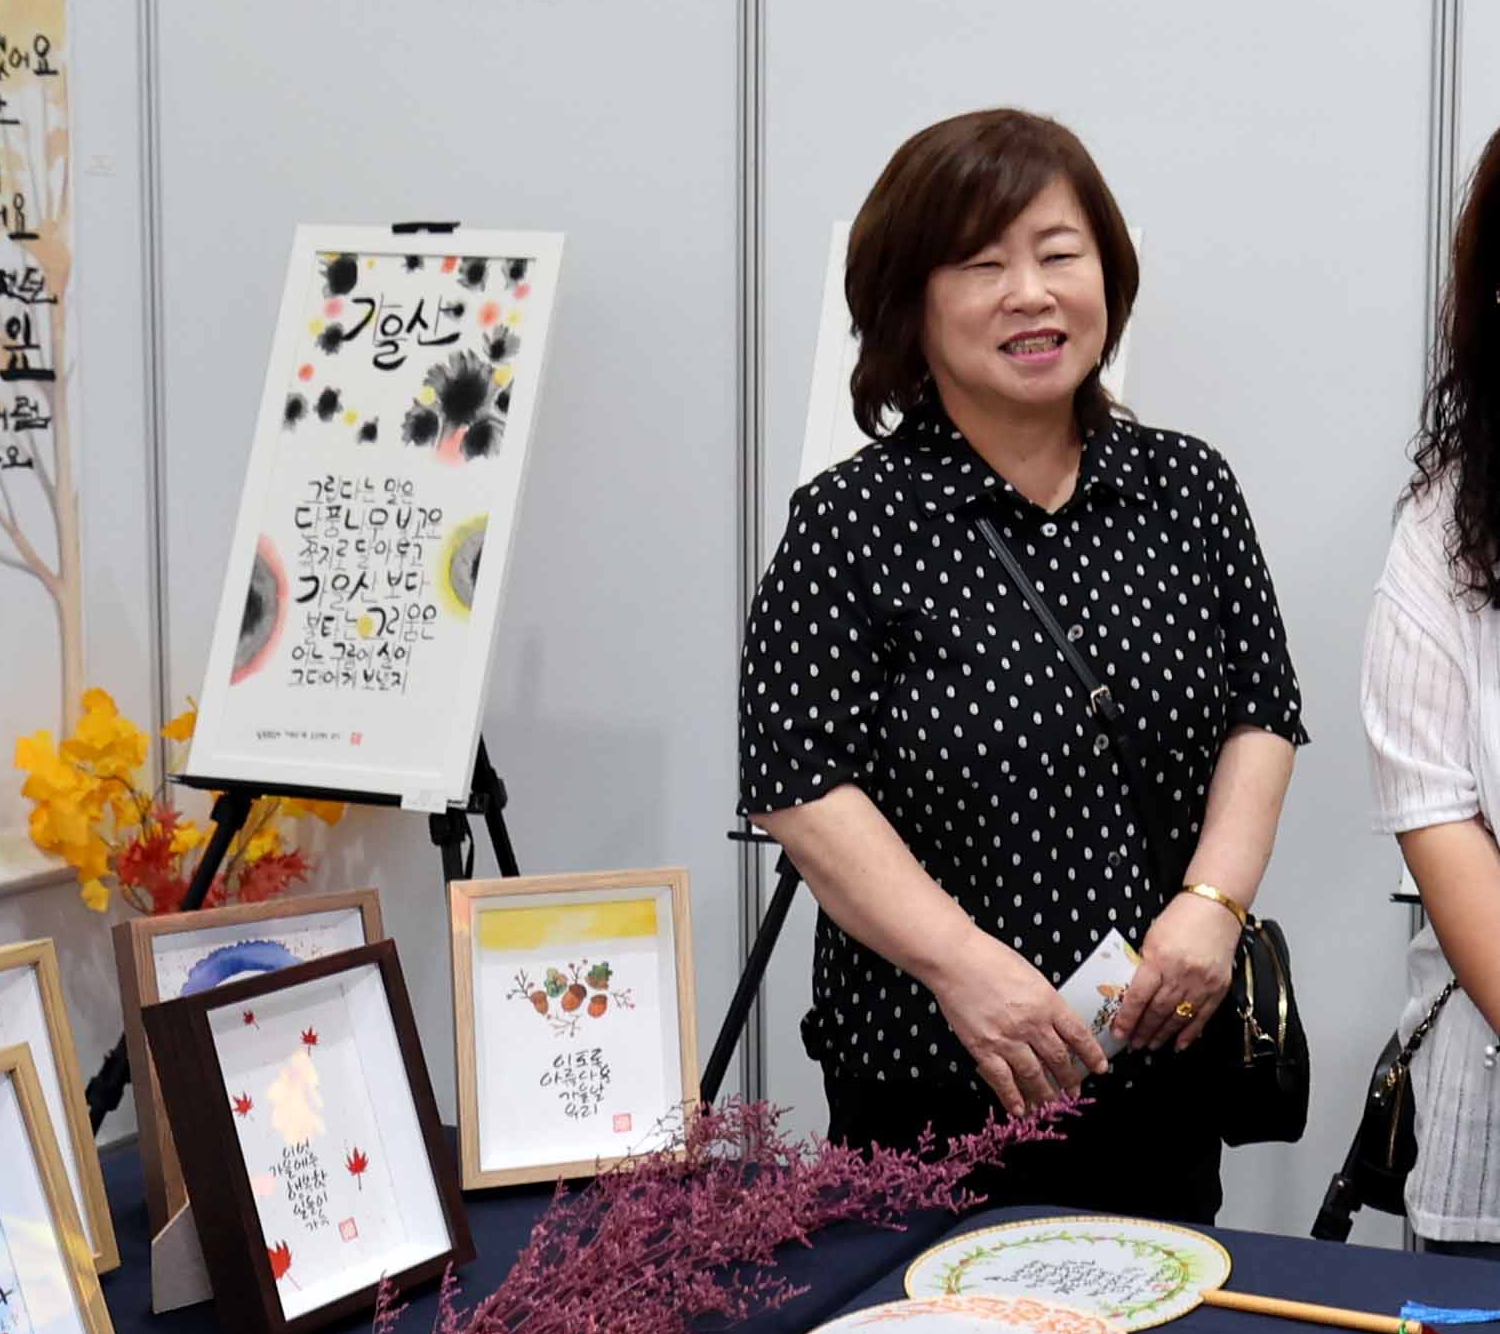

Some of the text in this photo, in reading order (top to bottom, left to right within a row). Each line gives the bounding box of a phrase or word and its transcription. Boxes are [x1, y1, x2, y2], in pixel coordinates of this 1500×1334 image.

[339, 293, 465, 370] 가을산
[385, 478, 413, 504] 말은
[294, 506, 389, 540] 단풍나무
[295, 571, 430, 610] 가을산 보다
